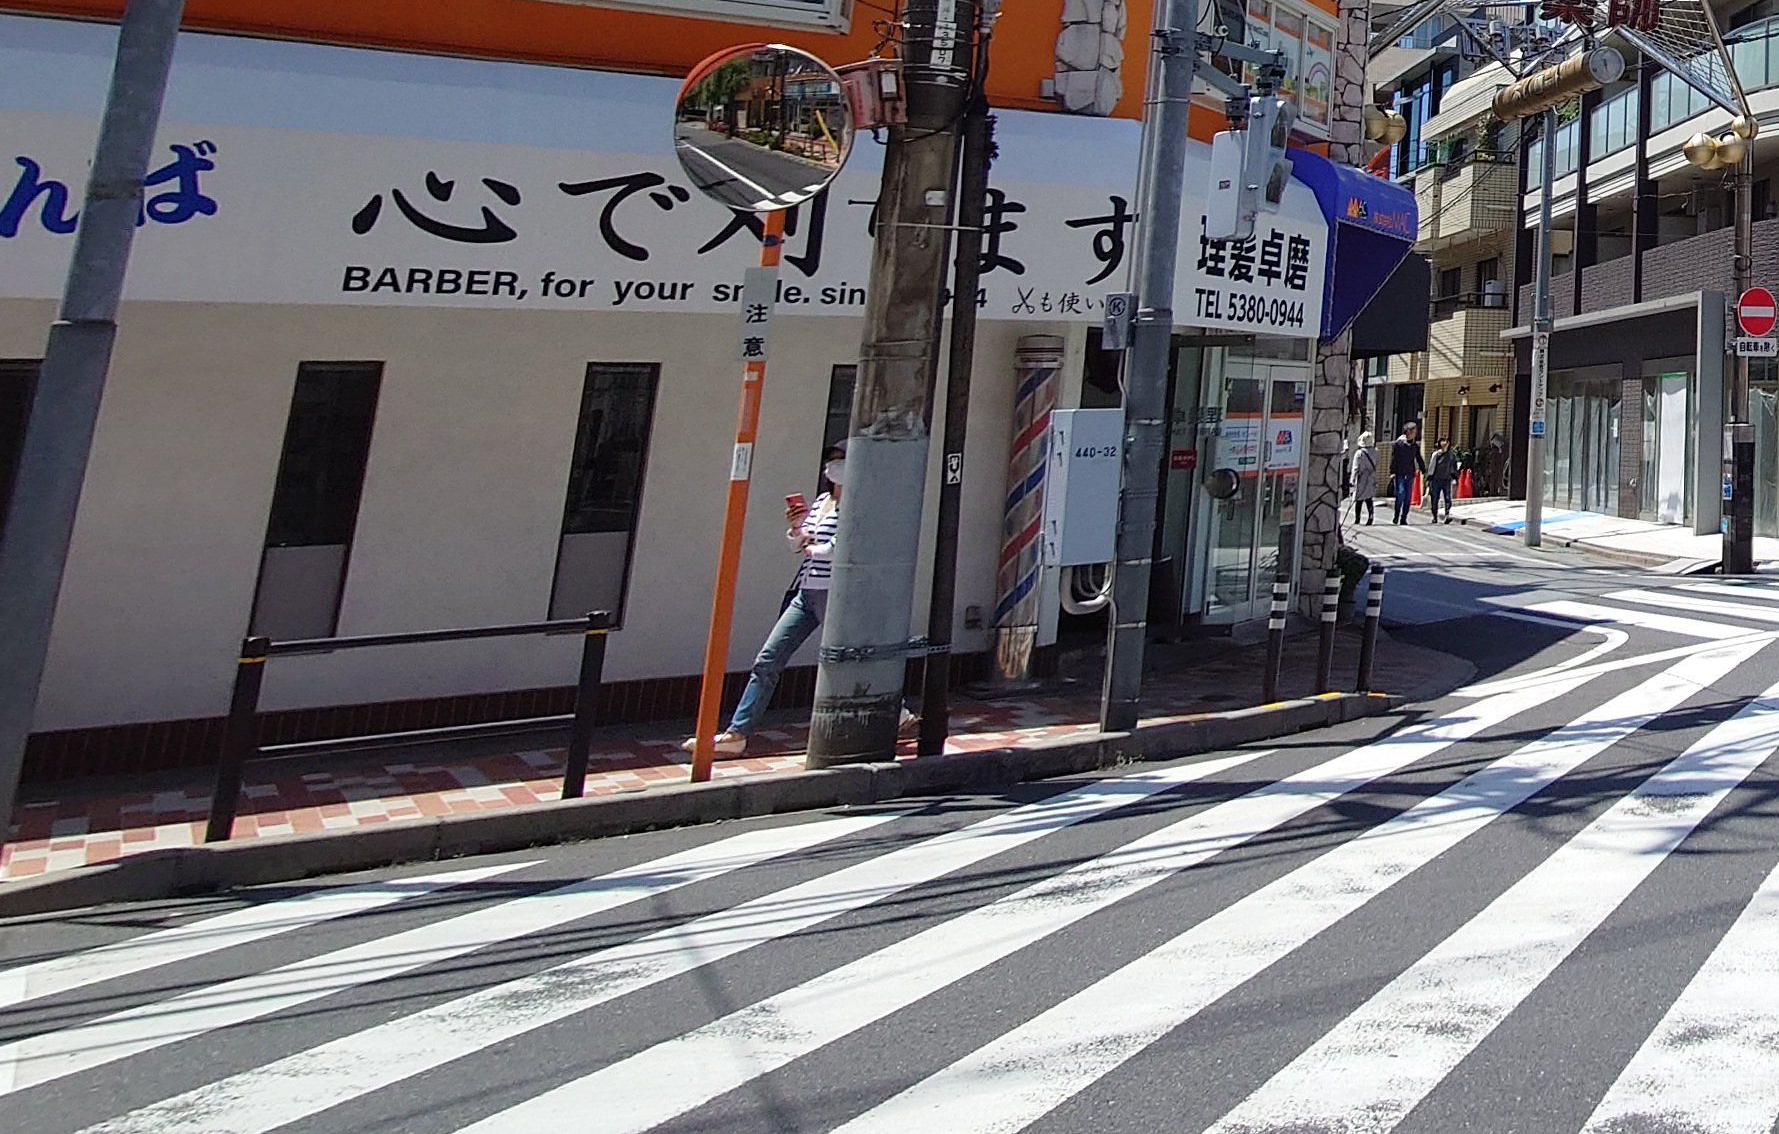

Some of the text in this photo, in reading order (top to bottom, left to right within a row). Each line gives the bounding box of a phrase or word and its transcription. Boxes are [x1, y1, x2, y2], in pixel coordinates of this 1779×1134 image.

[342, 266, 529, 301] BARBER,
[541, 272, 595, 298] for
[612, 279, 694, 306] your
[713, 279, 810, 304] sle.
[1195, 288, 1304, 328] TEL 5380-0944
[743, 303, 768, 357] 注意
[1075, 447, 1117, 458] 440-32
